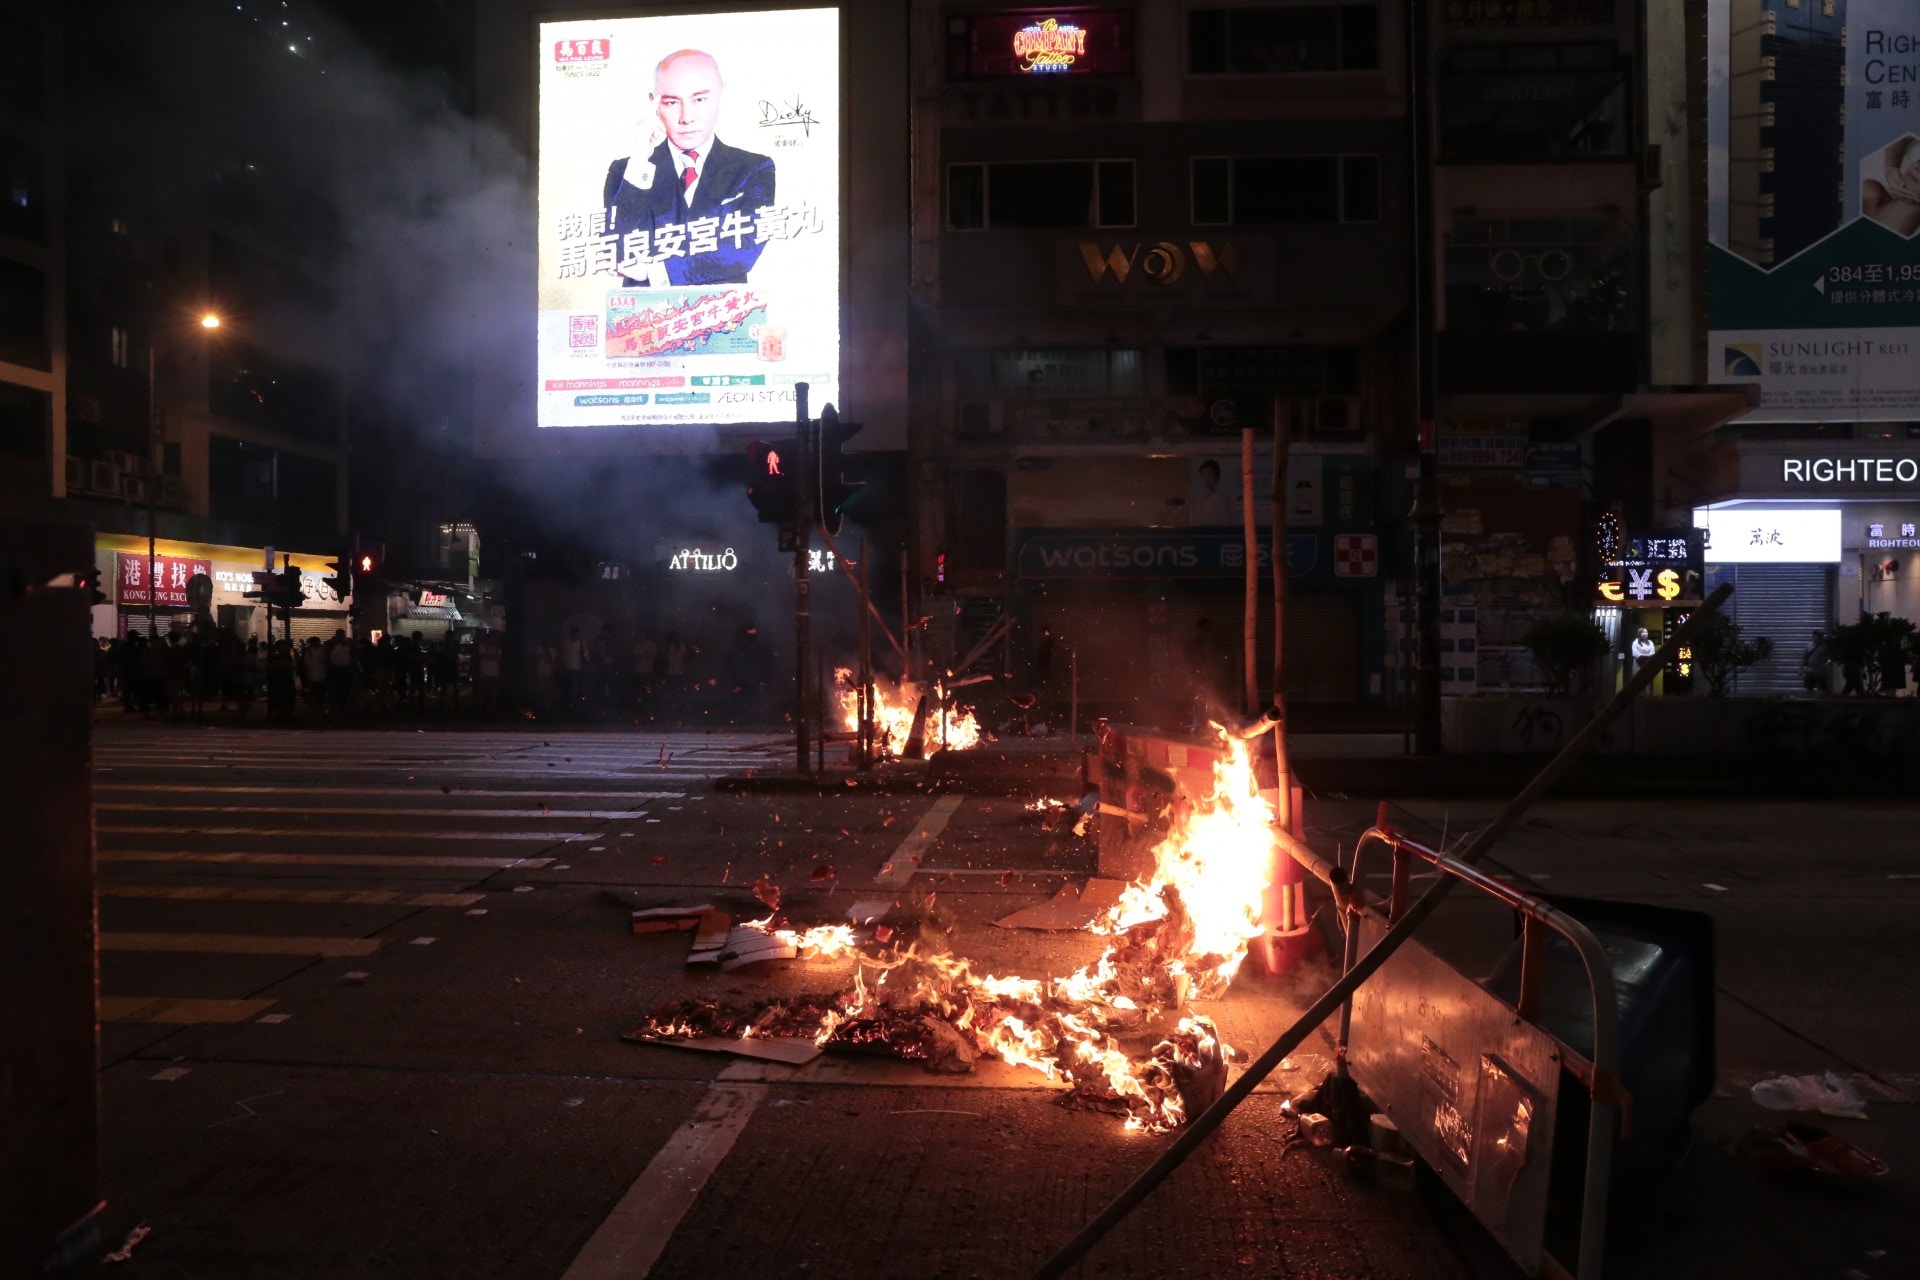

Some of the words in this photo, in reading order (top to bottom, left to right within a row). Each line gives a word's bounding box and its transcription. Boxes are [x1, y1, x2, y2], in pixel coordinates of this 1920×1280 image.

[1014, 29, 1087, 55] COMPANY
[1020, 49, 1075, 71] Tattoo
[1078, 241, 1246, 288] WOW
[1769, 341, 1873, 357] SUNLIGHT
[1880, 344, 1908, 356] REIT
[1784, 459, 1918, 482] RIGHTEO
[1040, 544, 1200, 568] watsons
[124, 589, 146, 601] KONG
[1628, 568, 1653, 601] ¥
[1657, 568, 1681, 601] $
